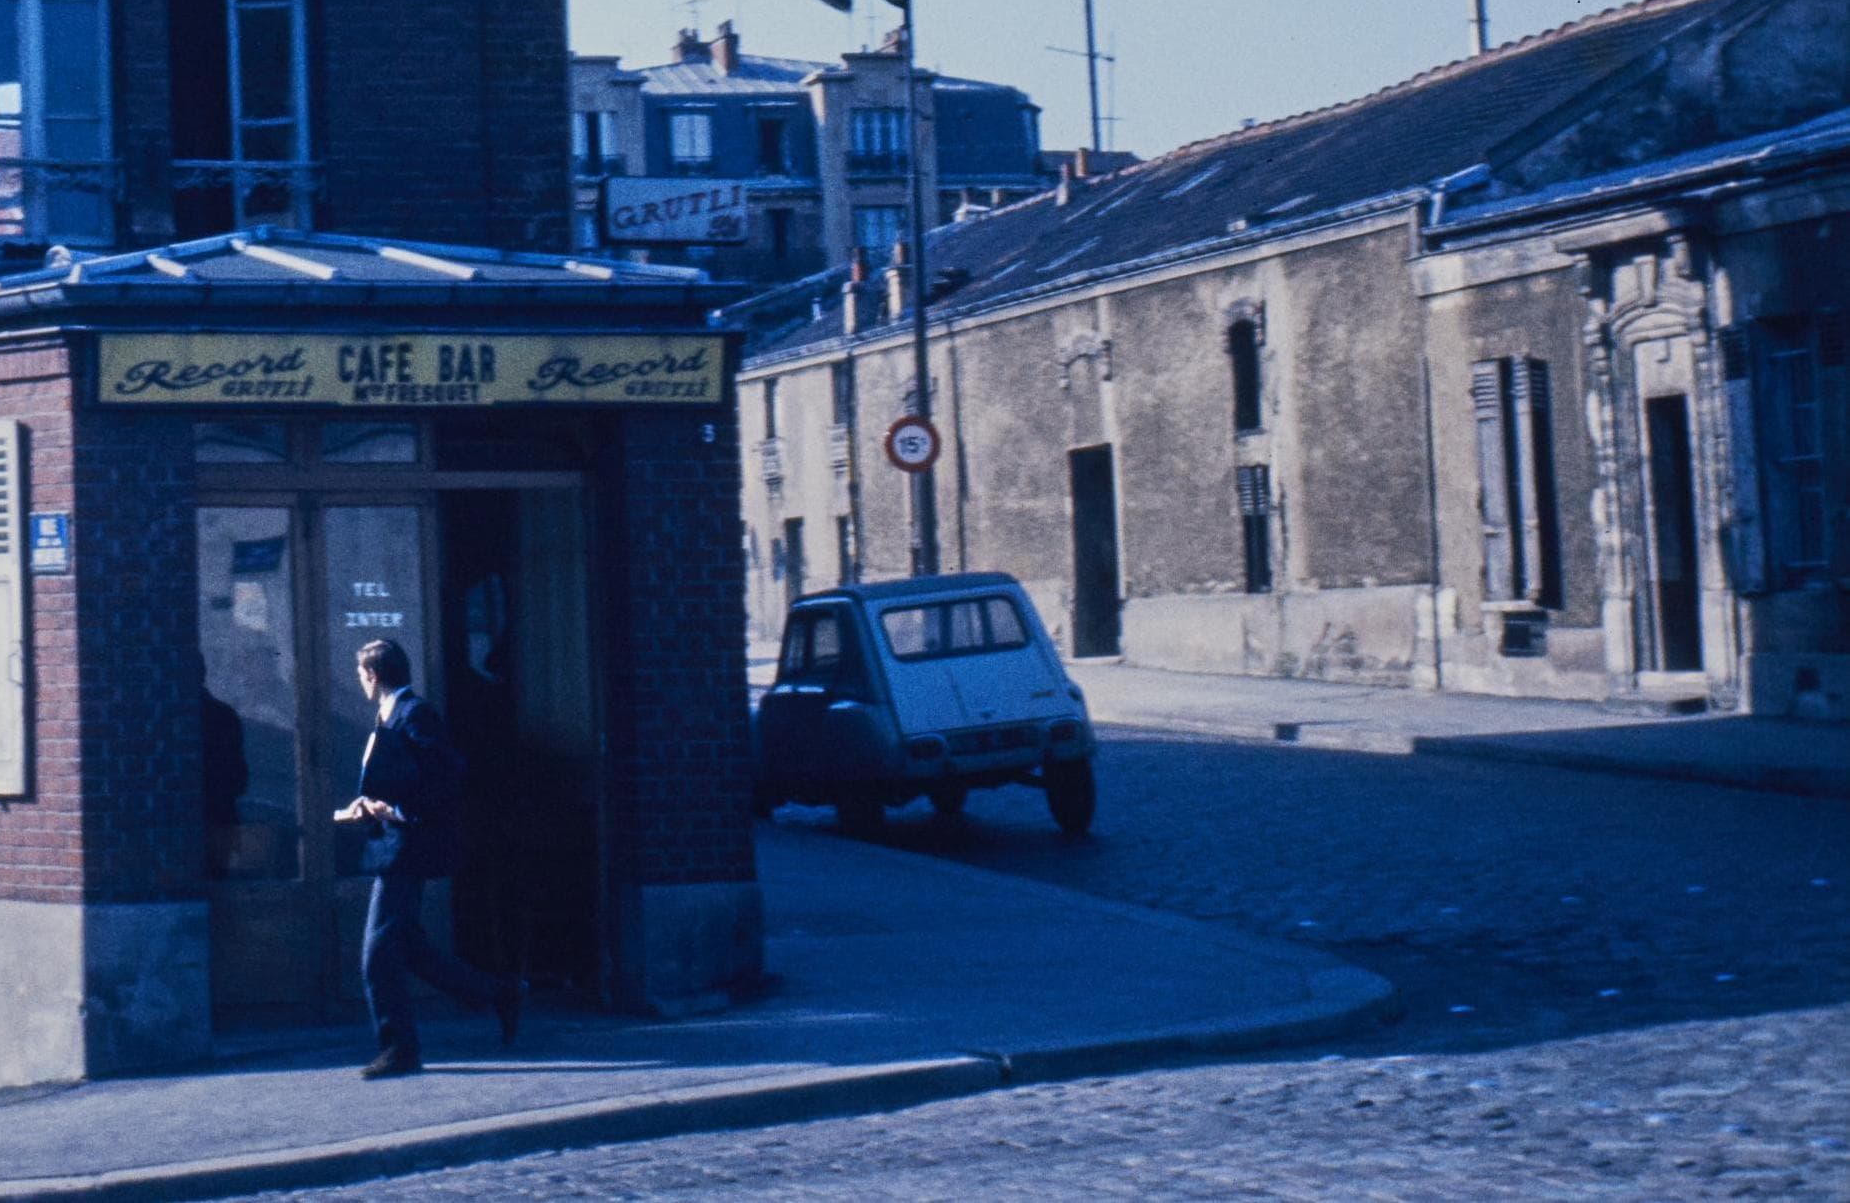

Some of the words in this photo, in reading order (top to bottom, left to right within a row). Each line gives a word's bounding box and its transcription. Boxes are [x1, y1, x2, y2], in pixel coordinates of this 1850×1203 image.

[614, 185, 742, 229] GRUTLI
[114, 347, 306, 394] Record
[337, 342, 414, 383] CAFE
[439, 344, 496, 383] BAR
[527, 348, 709, 391] Record
[353, 582, 390, 597] TEL
[345, 612, 404, 627] INTER
